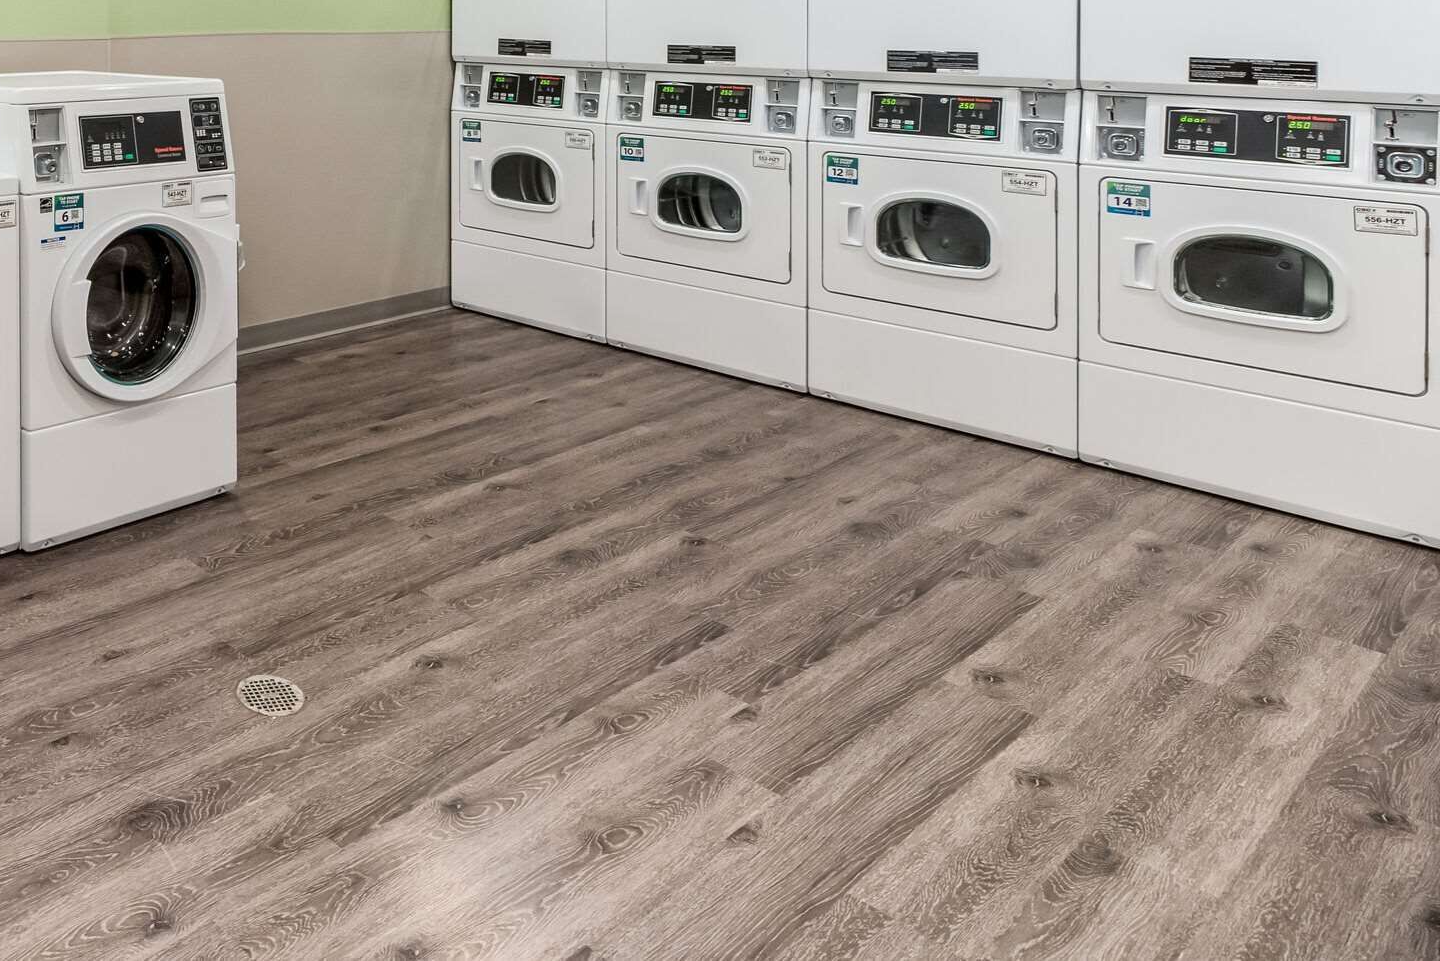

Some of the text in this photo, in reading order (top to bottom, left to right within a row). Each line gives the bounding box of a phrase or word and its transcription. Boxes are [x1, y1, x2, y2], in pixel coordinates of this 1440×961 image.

[832, 168, 843, 176] 12
[1114, 196, 1133, 207] 14
[62, 211, 69, 222] 6
